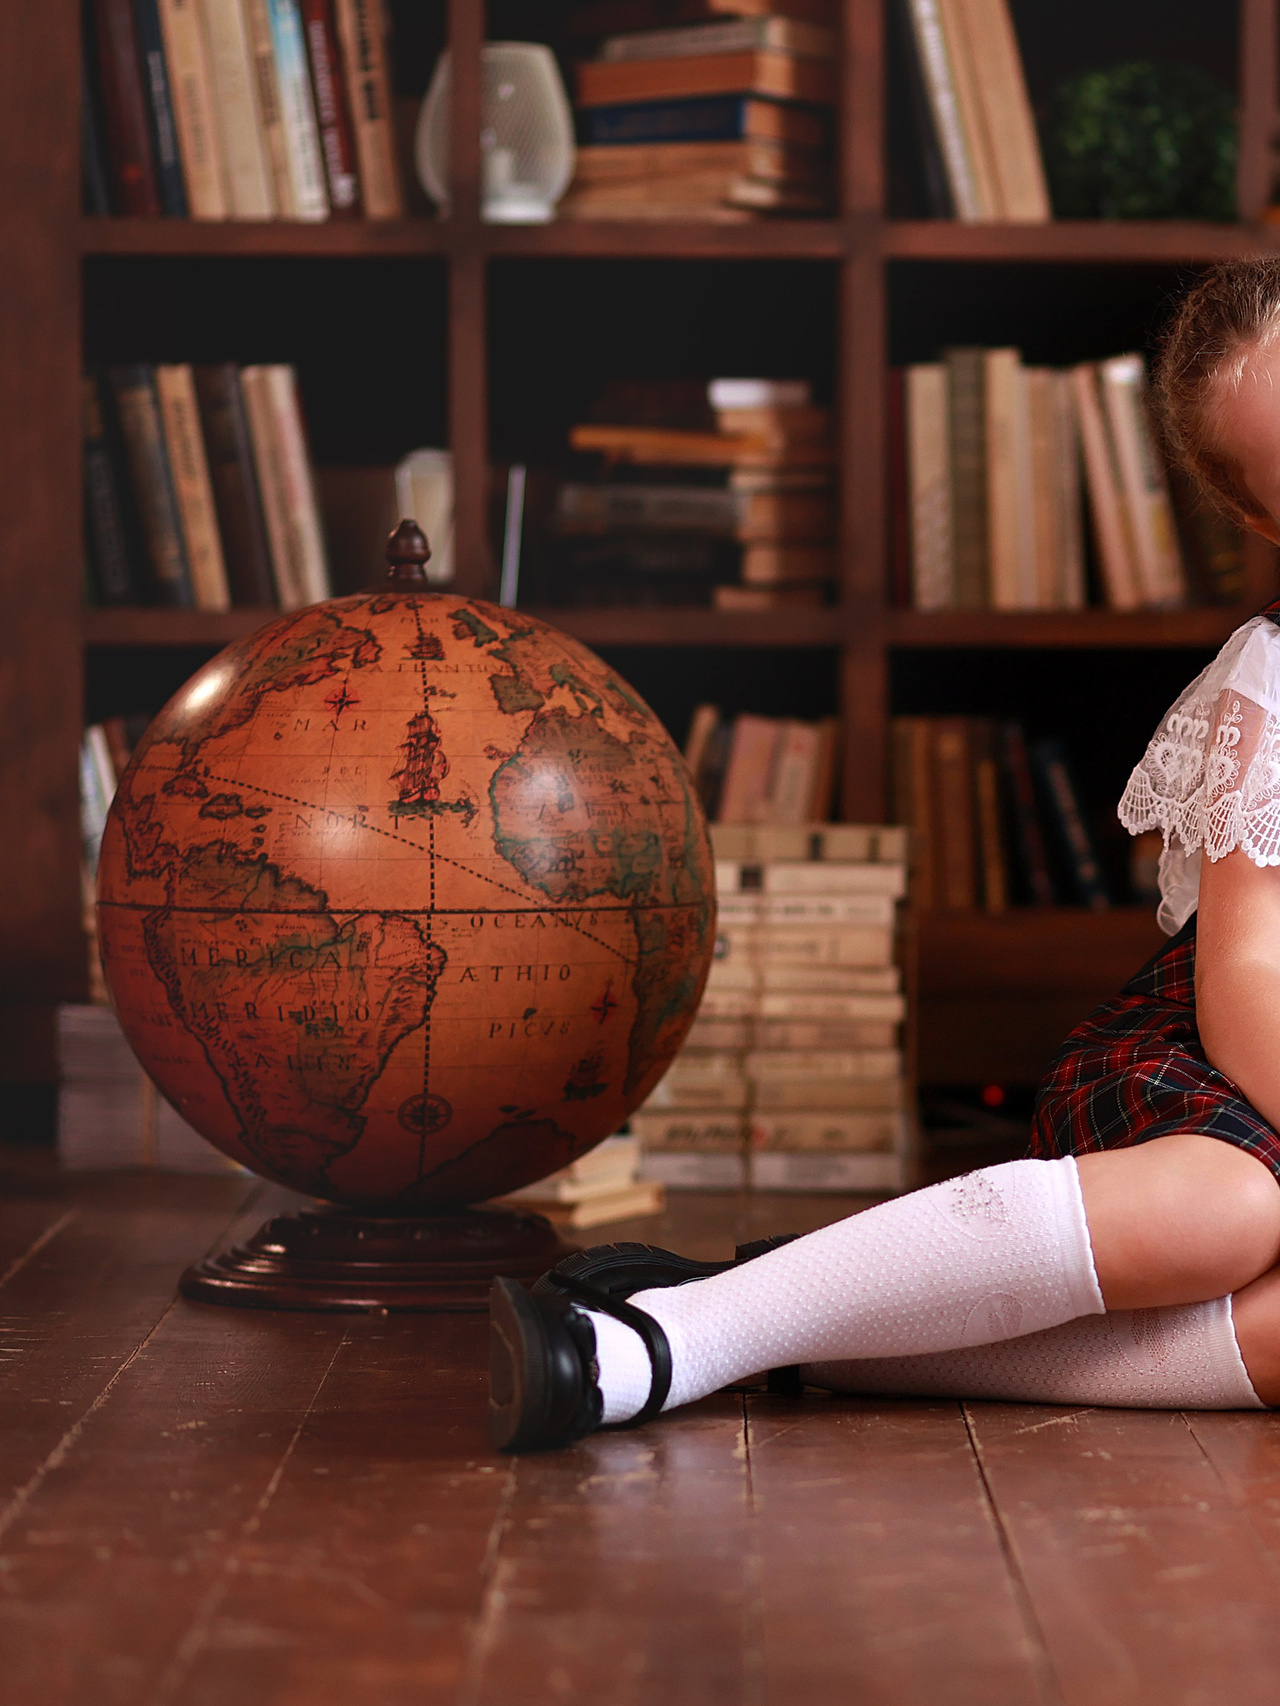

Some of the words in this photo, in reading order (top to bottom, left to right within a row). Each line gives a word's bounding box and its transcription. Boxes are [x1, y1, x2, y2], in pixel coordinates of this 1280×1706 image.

[293, 718, 369, 732] MAR
[470, 913, 599, 929] OCEANVS
[488, 1021, 571, 1039] PICVS
